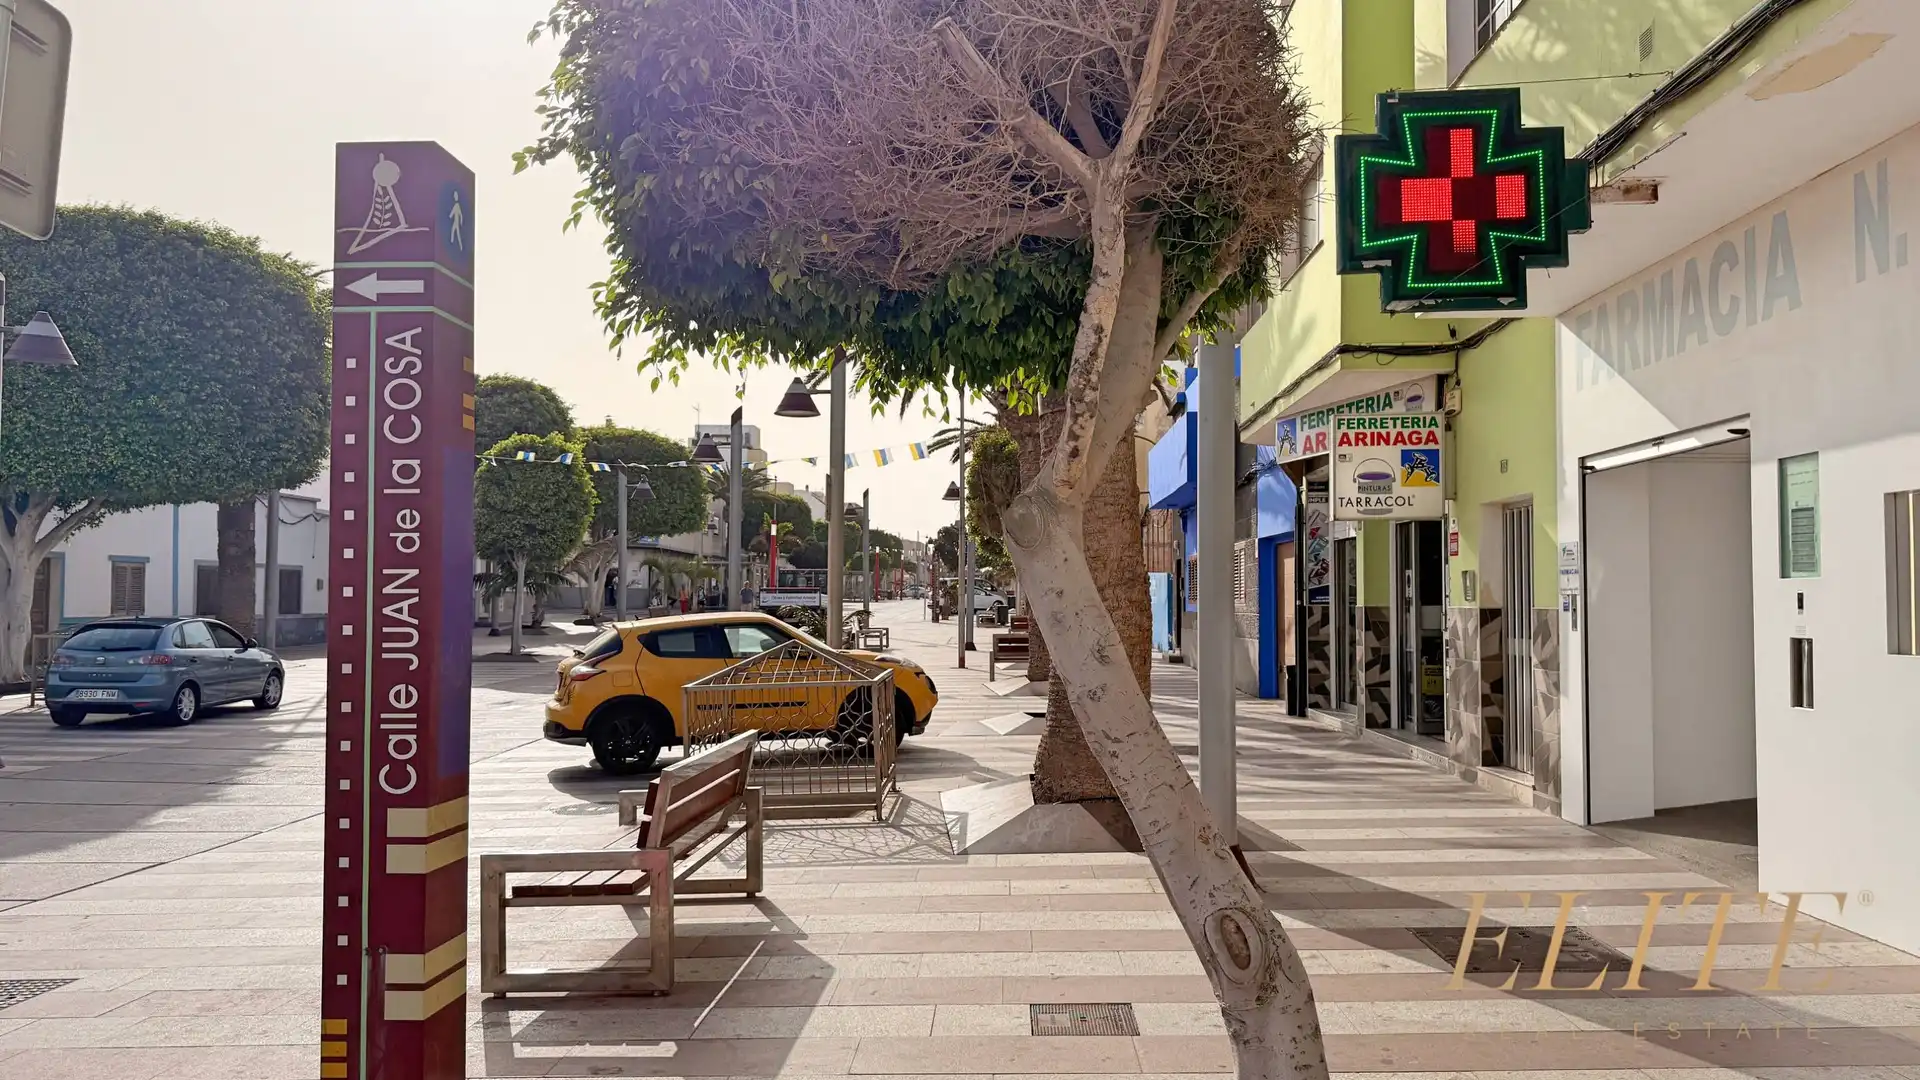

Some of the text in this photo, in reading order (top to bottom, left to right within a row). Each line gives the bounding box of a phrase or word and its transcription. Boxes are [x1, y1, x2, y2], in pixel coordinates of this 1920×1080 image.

[1575, 210, 1803, 393] FARMACIA
[1337, 416, 1440, 430] FERRETERIA
[1337, 430, 1440, 447] ARINAGA
[1358, 485, 1392, 493] PINTURAS
[378, 326, 422, 796] Calle JUAN de la COSA
